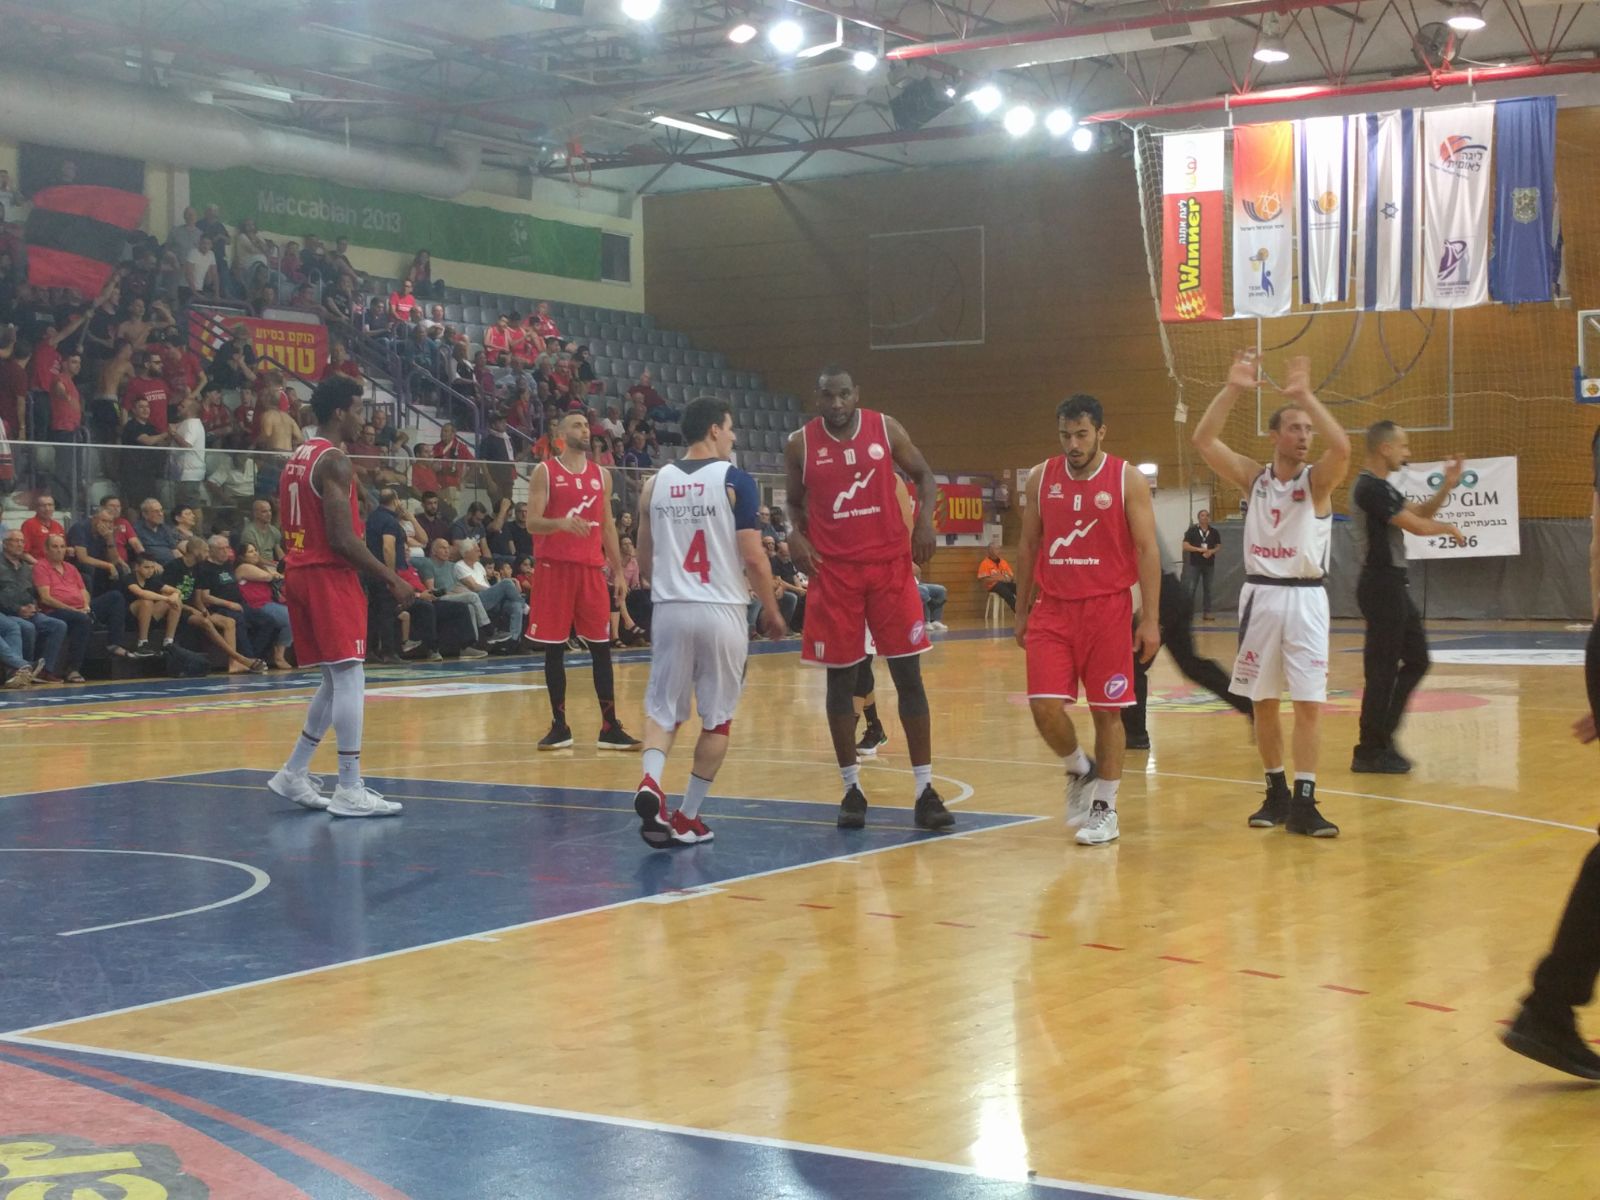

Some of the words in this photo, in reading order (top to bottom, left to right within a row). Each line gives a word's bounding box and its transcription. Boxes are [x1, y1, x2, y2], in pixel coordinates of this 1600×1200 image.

[258, 190, 357, 226] Maccabian
[362, 206, 401, 233] 2013
[1179, 197, 1200, 291] Winner
[289, 331, 315, 345] הוקם
[948, 496, 983, 520] טוטו
[1460, 490, 1499, 507] GLM
[1271, 508, 1281, 529] 7
[682, 529, 711, 584] 4
